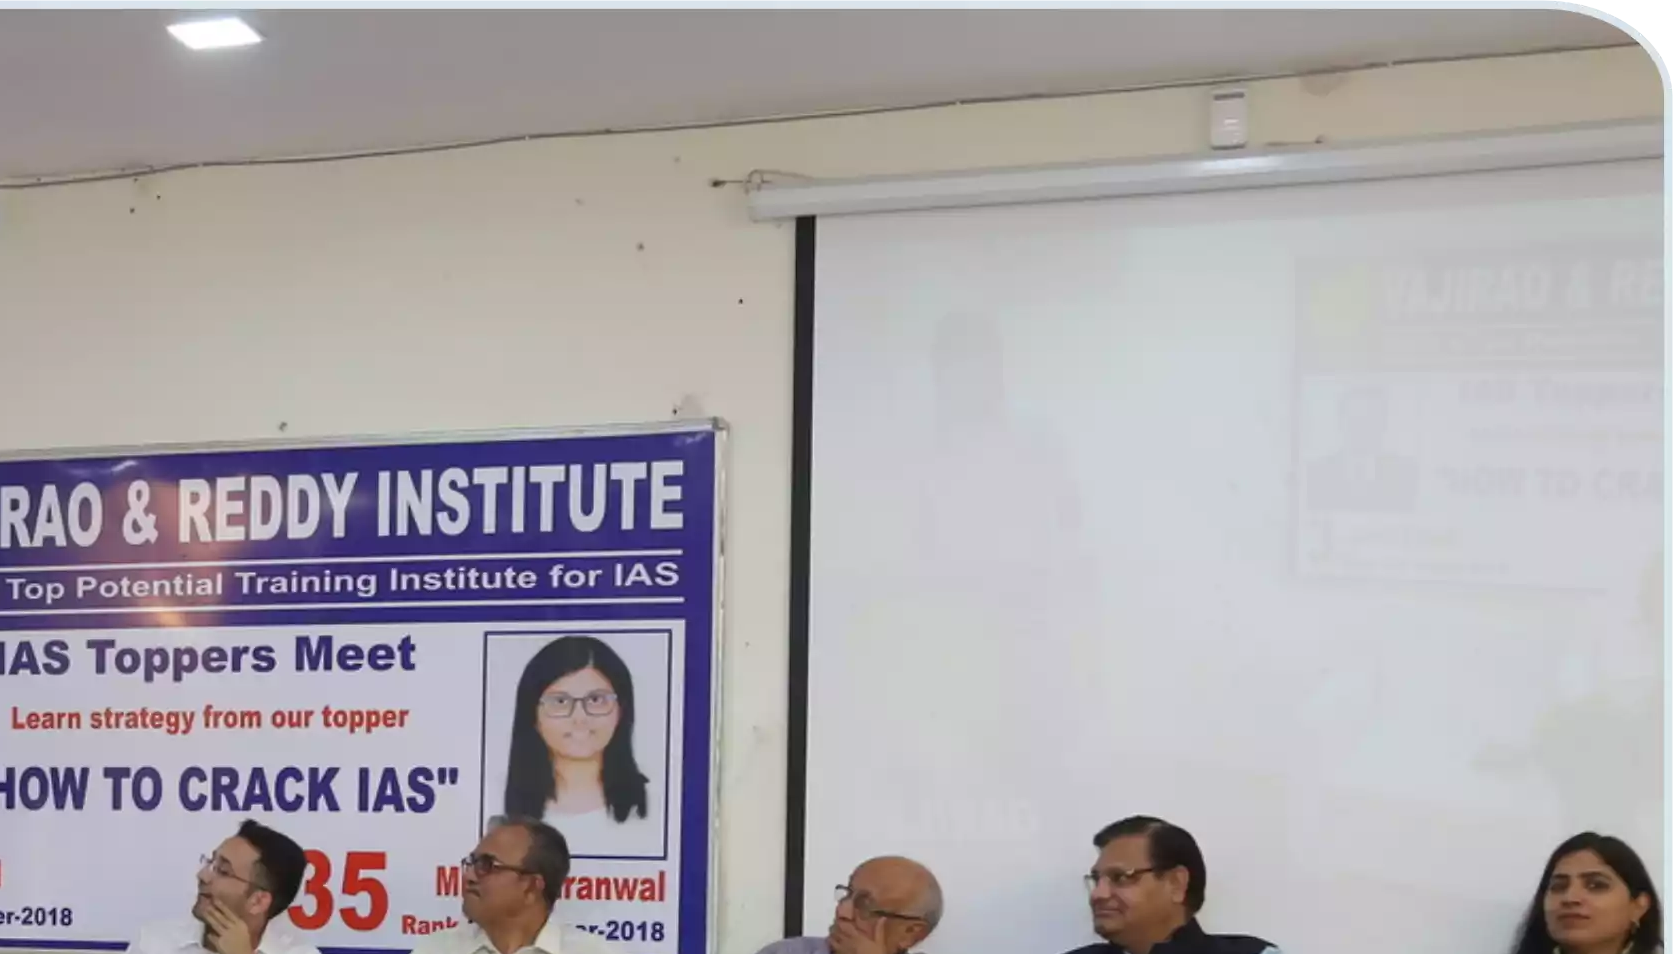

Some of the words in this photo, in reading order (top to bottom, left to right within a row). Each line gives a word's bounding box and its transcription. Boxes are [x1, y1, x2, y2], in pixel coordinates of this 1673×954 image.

[122, 479, 159, 546] &
[178, 471, 359, 543] REDDY
[377, 460, 684, 537] INSTITUTE
[6, 577, 65, 605] Top
[76, 573, 223, 599] Potential
[235, 570, 378, 598] Training
[390, 564, 537, 592] Institute
[549, 563, 603, 588] for
[614, 562, 680, 587] IAS
[87, 638, 277, 683] Toppers
[294, 635, 417, 673] Meet
[10, 706, 82, 730] Learn
[90, 706, 195, 735] strategy
[203, 704, 263, 729] from
[271, 707, 314, 729] our
[322, 704, 410, 734] topper
[104, 766, 163, 812] TO
[178, 766, 342, 813] CRACK
[358, 766, 460, 814] IAS"
[288, 849, 390, 932] 35
[562, 870, 666, 902] ranwal
